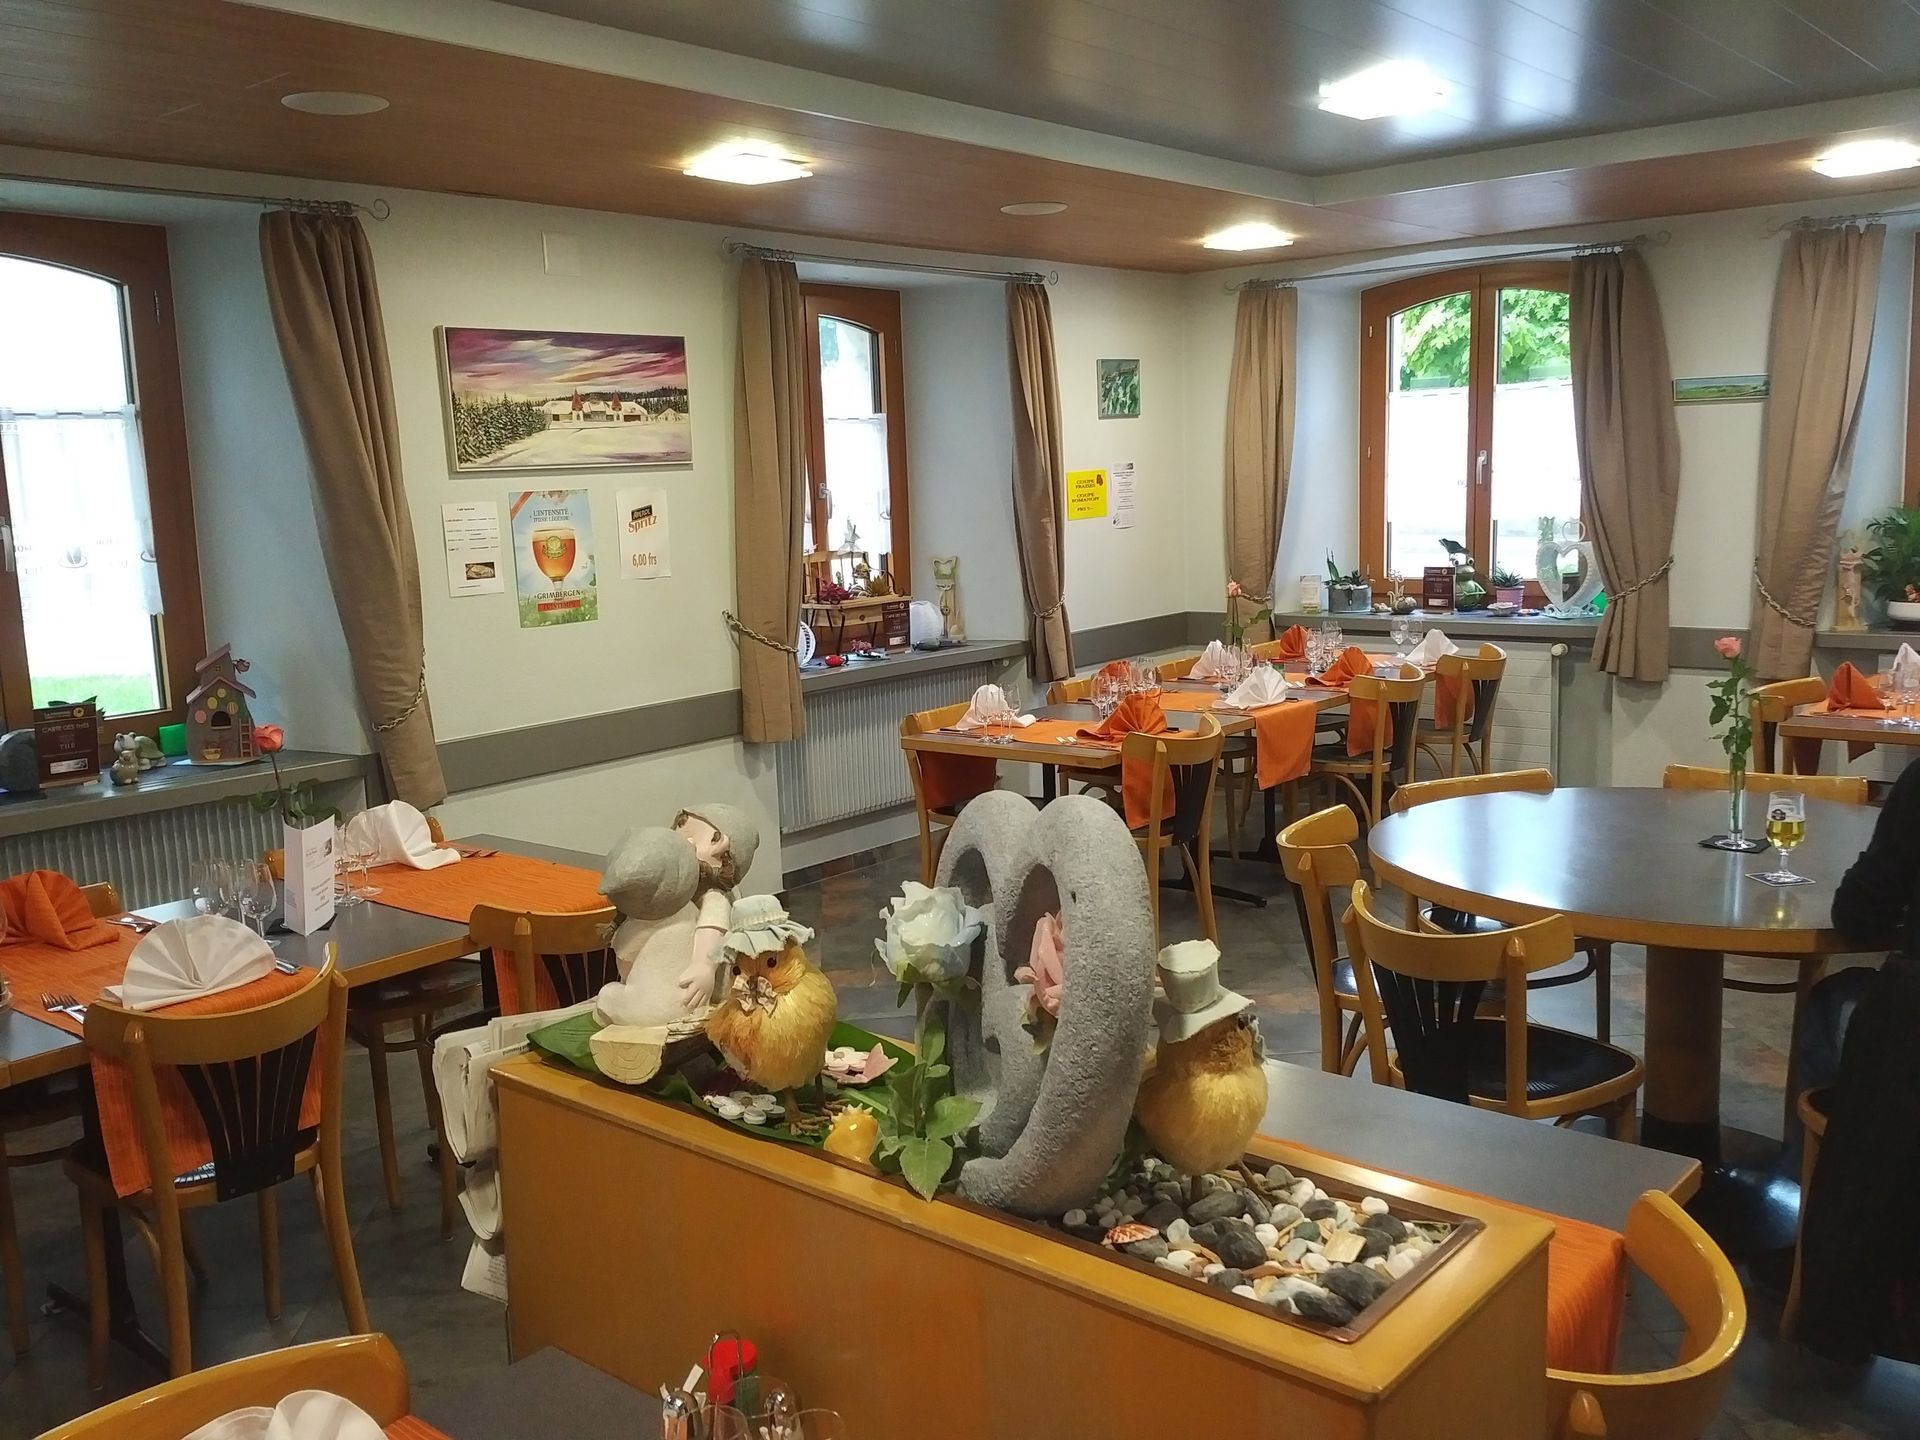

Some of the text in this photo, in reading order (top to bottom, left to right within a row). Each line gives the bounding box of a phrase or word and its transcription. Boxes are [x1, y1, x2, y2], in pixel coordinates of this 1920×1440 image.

[628, 515, 657, 533] Spritz
[632, 552, 657, 569] 6,00 frs
